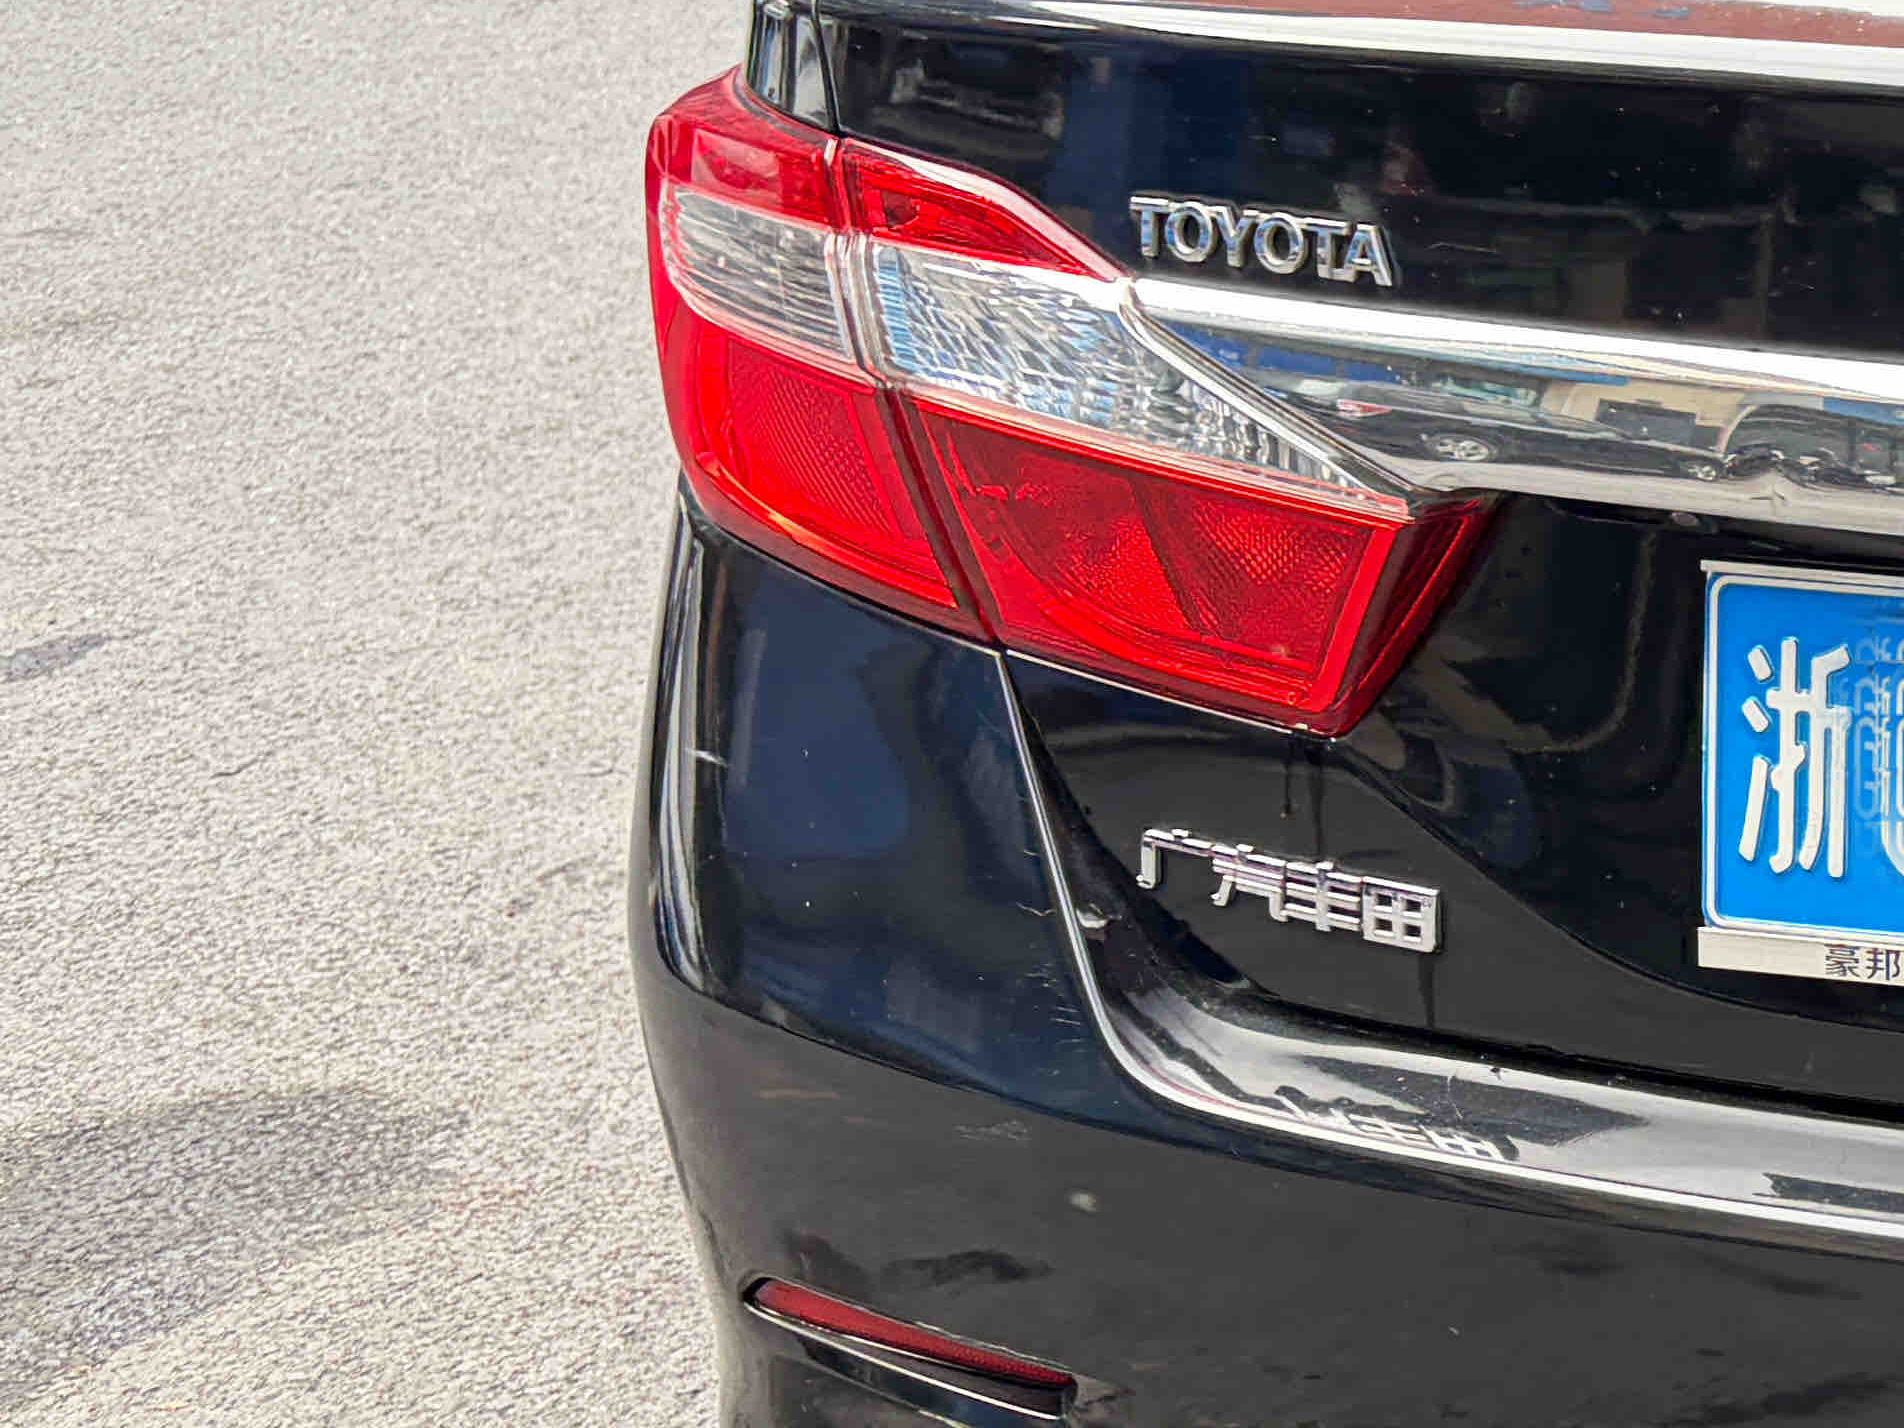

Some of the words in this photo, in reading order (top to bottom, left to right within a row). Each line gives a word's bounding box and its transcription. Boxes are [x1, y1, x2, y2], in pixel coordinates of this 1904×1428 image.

[1129, 192, 1393, 287] TOYOTA
[1136, 827, 1441, 954] 广汽丰田
